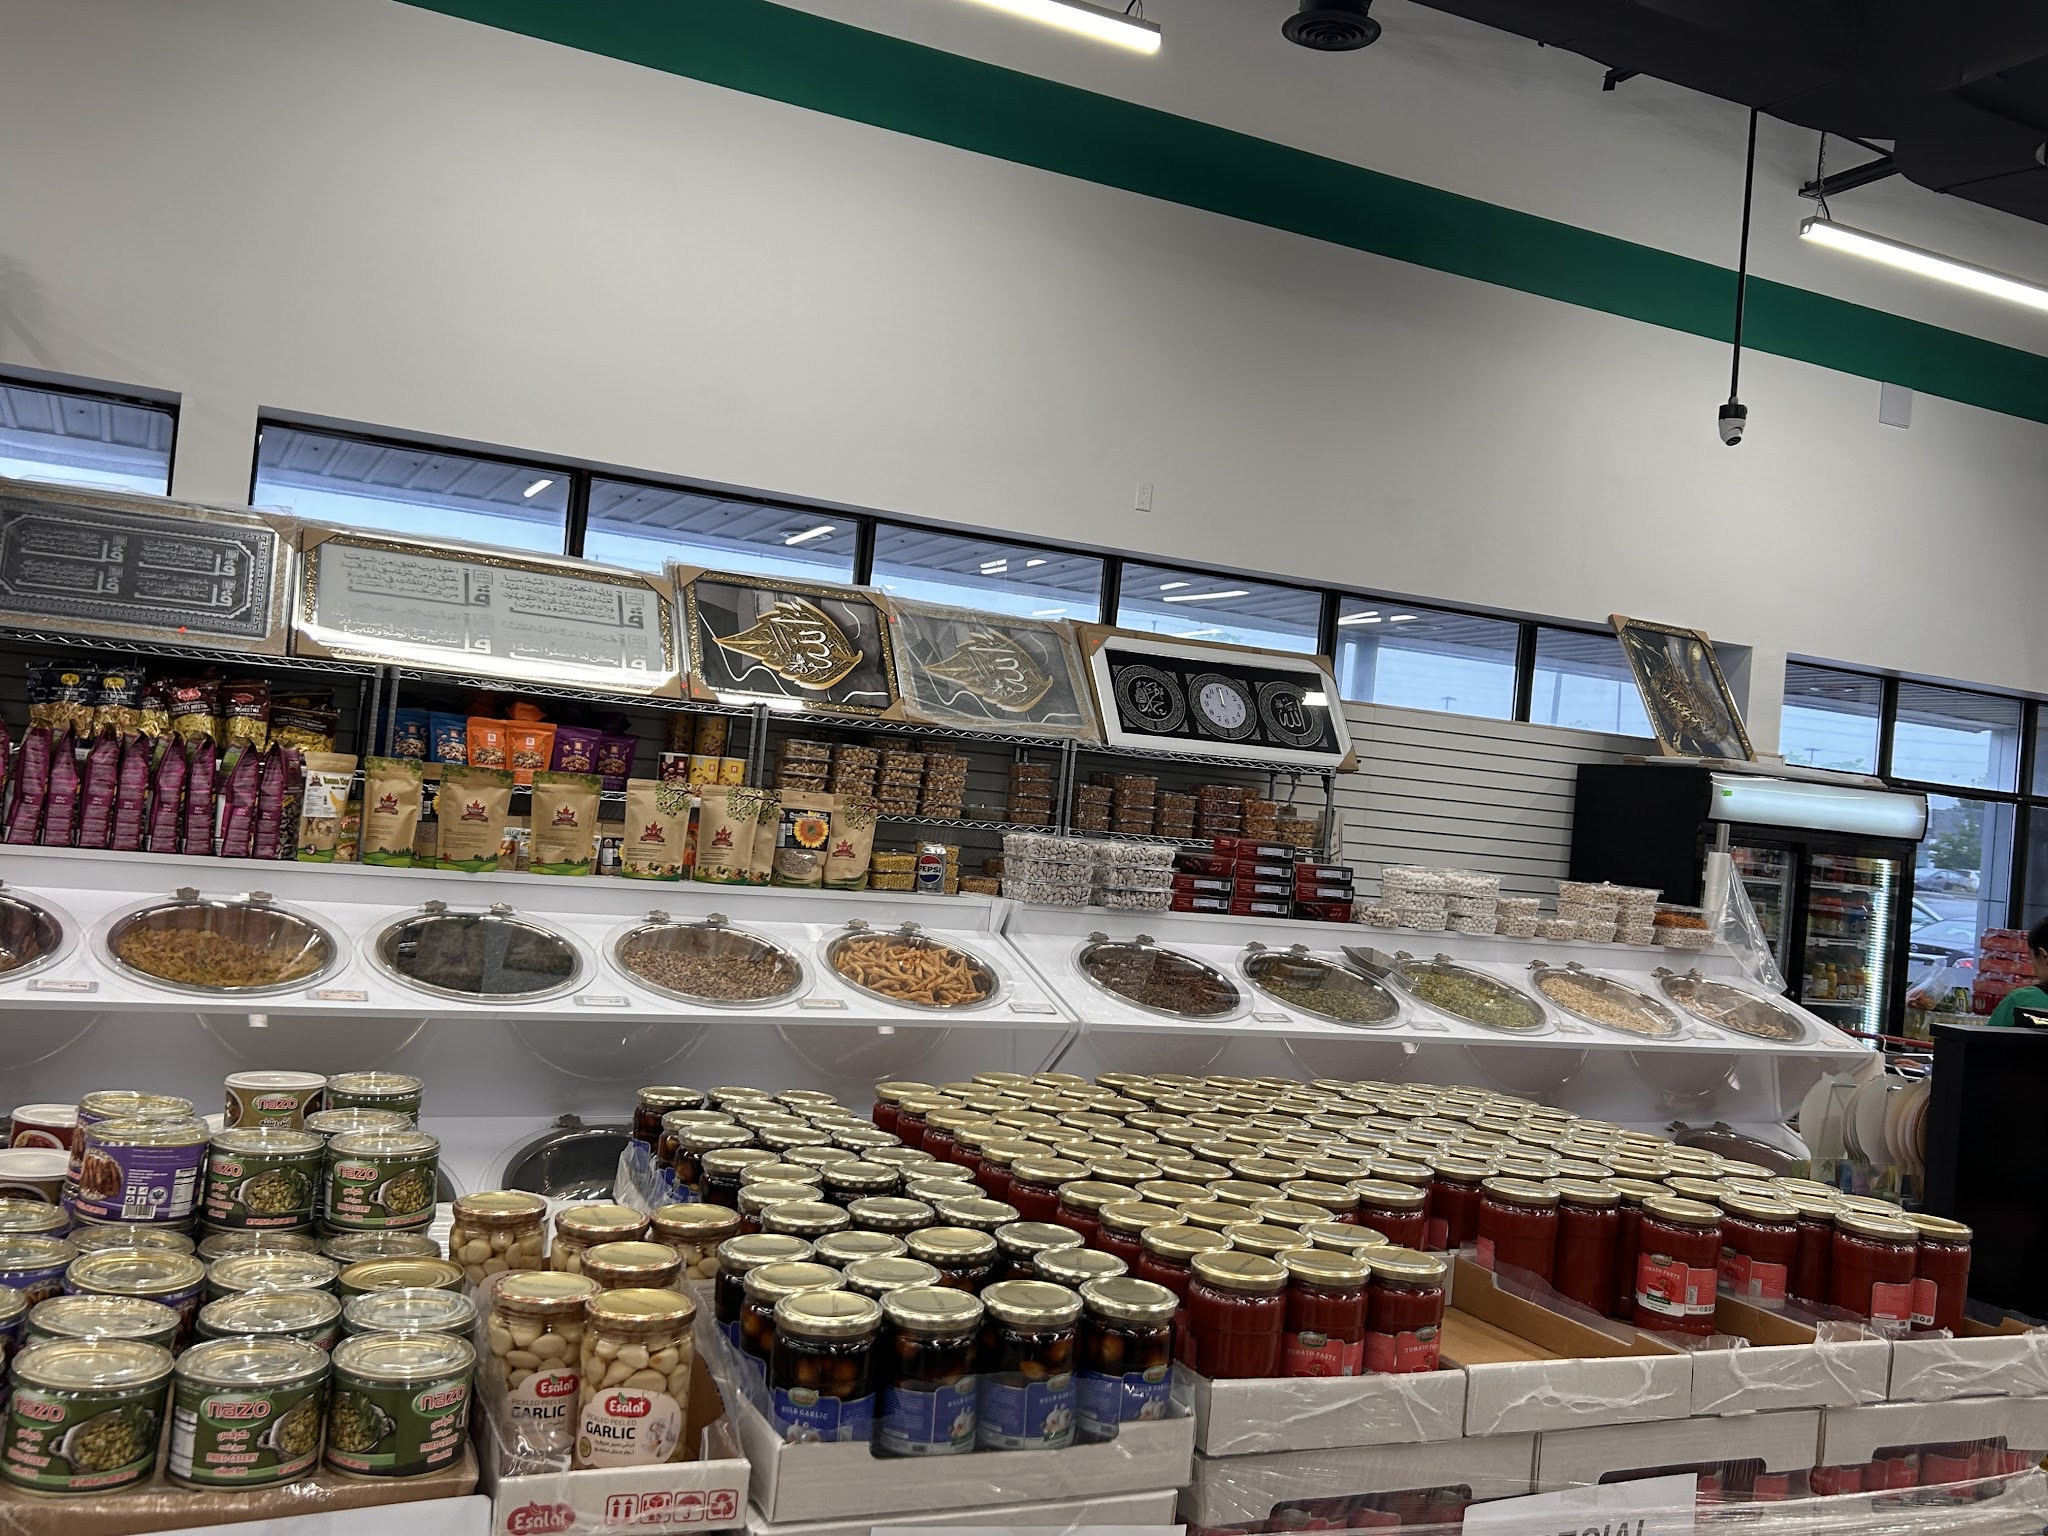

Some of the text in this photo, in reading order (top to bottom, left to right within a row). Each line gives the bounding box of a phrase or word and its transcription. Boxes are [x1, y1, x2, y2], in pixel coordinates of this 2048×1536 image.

[257, 1098, 299, 1109] nazo
[338, 1165, 379, 1181] nazo
[1664, 1270, 1680, 1280] PASTE
[1288, 1348, 1337, 1361] TOMATO PASTE
[1405, 1345, 1429, 1353] TOMATO
[541, 1378, 574, 1393] Esalat
[420, 1384, 466, 1411] nazo
[207, 1400, 271, 1419] nazo
[512, 1405, 566, 1418] GARLIC
[609, 1398, 645, 1416] Esalat
[782, 1405, 838, 1419] BULB GARLIC
[586, 1413, 609, 1424] PICKLED
[586, 1421, 636, 1439] GARLIC
[514, 1508, 568, 1531] Esalat
